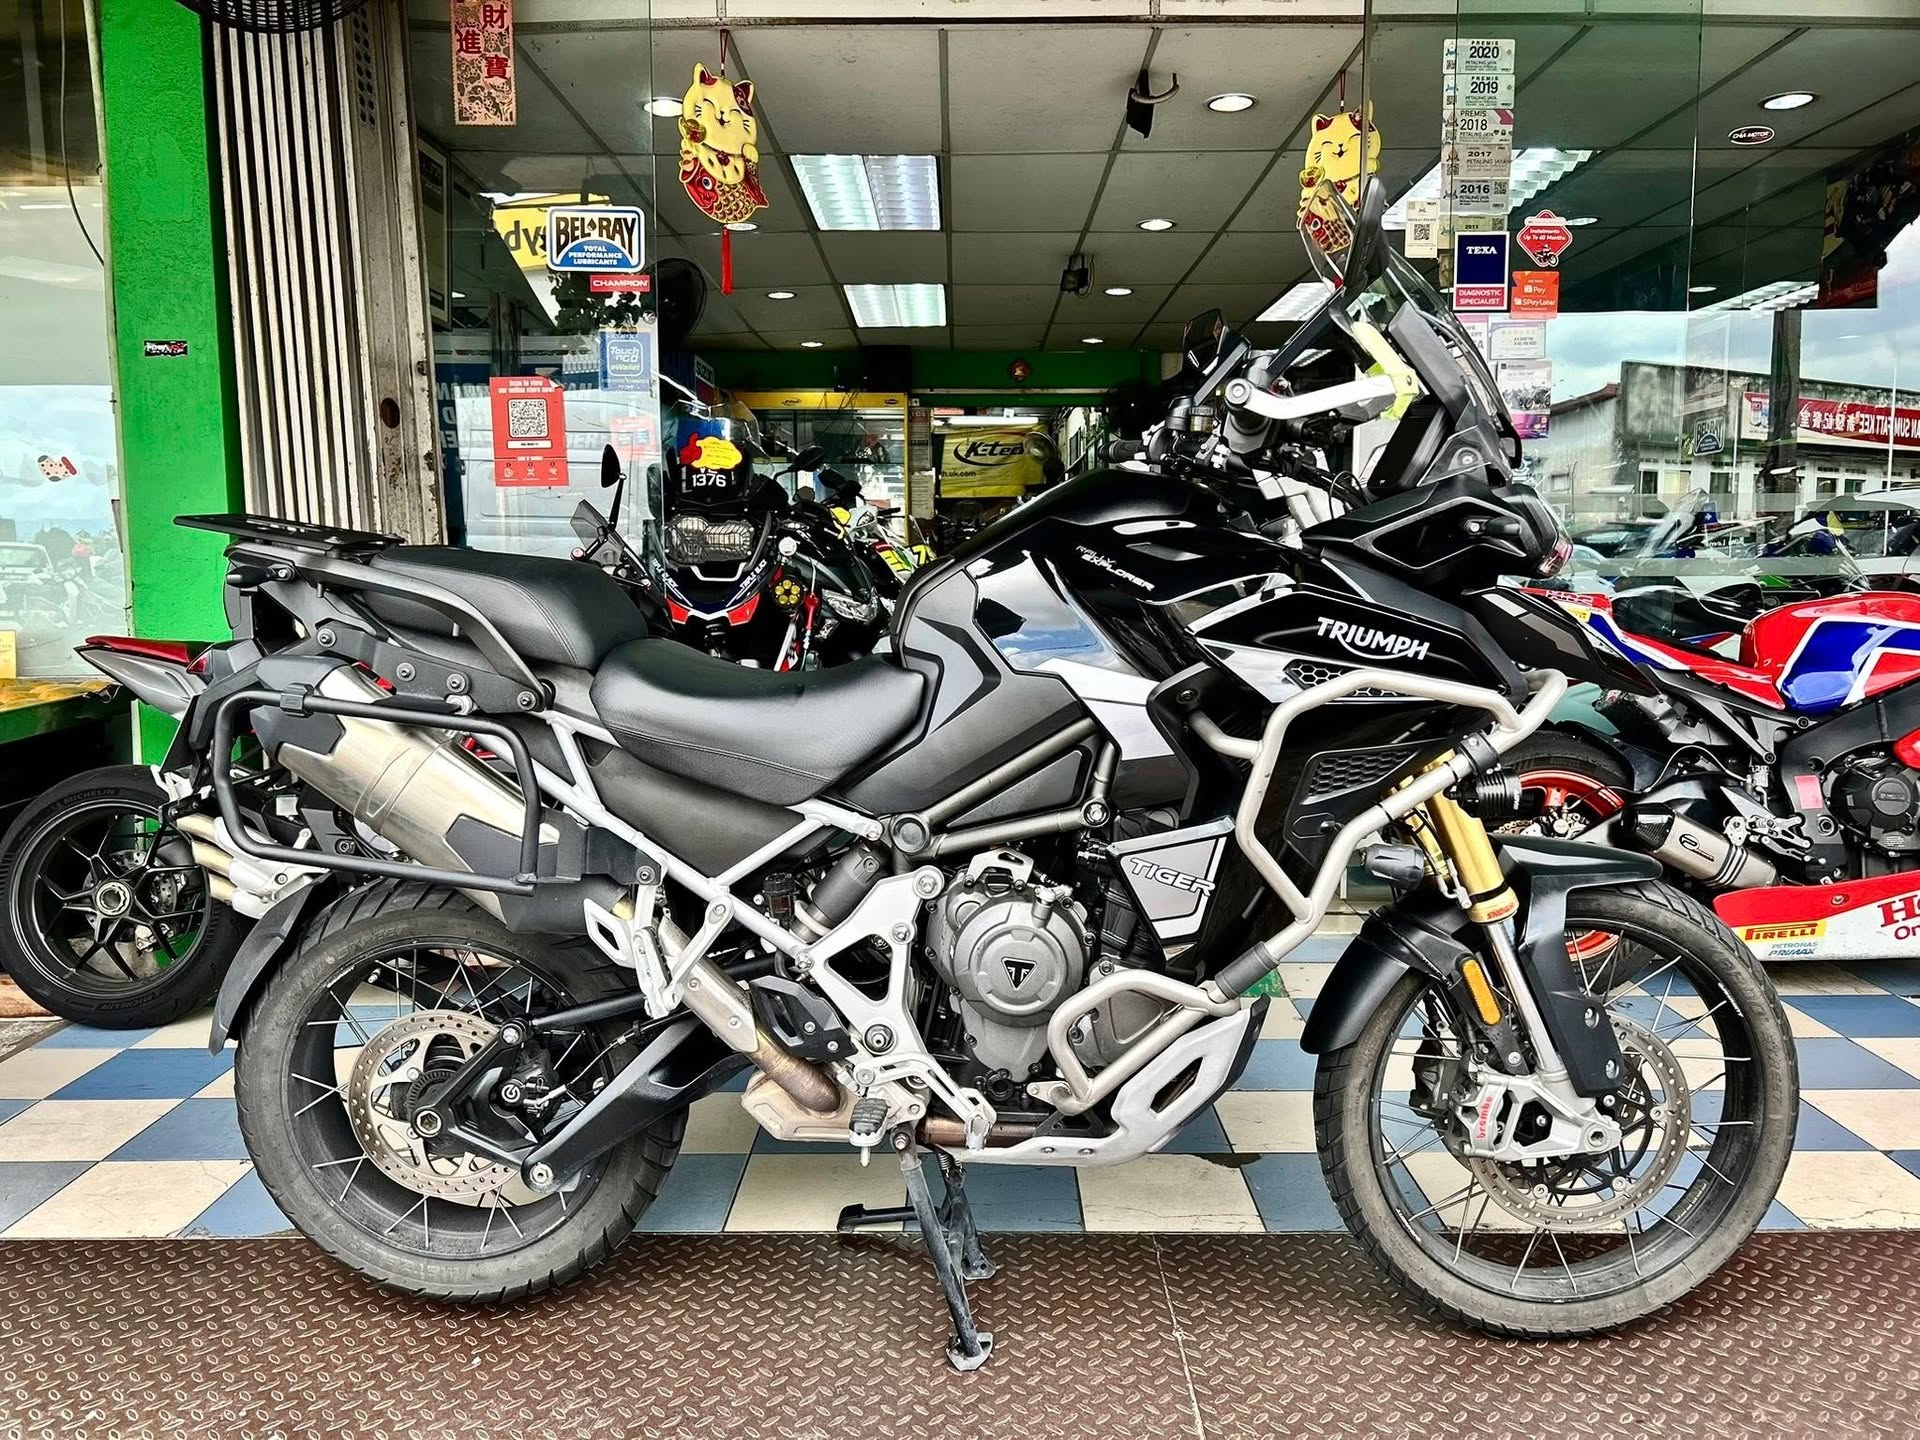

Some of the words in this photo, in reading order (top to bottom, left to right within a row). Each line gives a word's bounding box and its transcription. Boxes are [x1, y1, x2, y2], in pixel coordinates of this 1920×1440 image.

[1469, 46, 1500, 59] 2020
[1470, 81, 1499, 94] 2019
[1460, 118, 1488, 131] 2018
[1460, 184, 1490, 194] 2016
[568, 251, 623, 259] PERFORMANCE
[1466, 246, 1498, 255] TEXA
[1459, 289, 1502, 297] DIAGNOSTIC
[1533, 285, 1546, 294] Pay
[610, 346, 639, 355] Touch
[610, 363, 640, 371] eWallet
[692, 474, 727, 487] 1376
[1081, 553, 1155, 592] EXPLORER
[1316, 616, 1431, 661] TRIUMPH
[63, 788, 117, 805] MICHELIN
[1130, 857, 1216, 897] TIGER
[1744, 922, 1818, 941] PIRELLI
[1771, 941, 1818, 949] PETRONAS
[1768, 948, 1815, 957] PRIMAX
[1476, 1095, 1494, 1141] brembo
